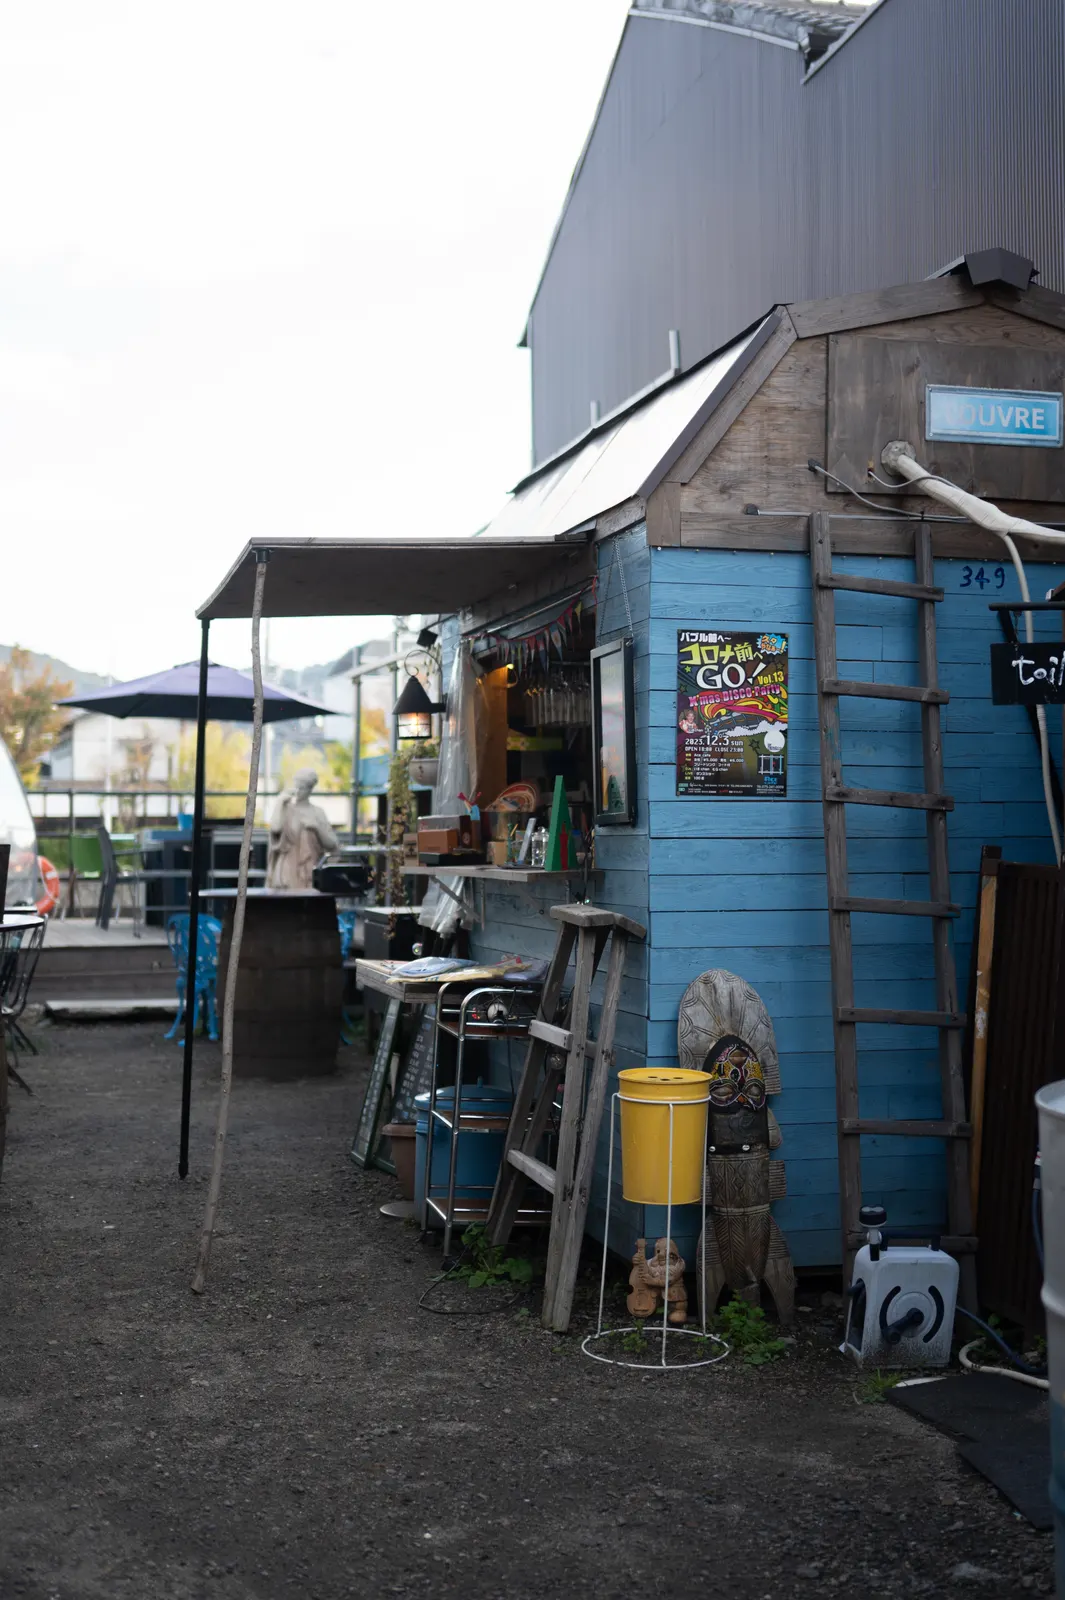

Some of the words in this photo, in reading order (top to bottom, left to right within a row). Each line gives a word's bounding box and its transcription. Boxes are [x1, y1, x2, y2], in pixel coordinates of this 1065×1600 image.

[960, 565, 1005, 590] 349
[696, 661, 767, 689] GO!
[757, 671, 785, 685] Vol.13
